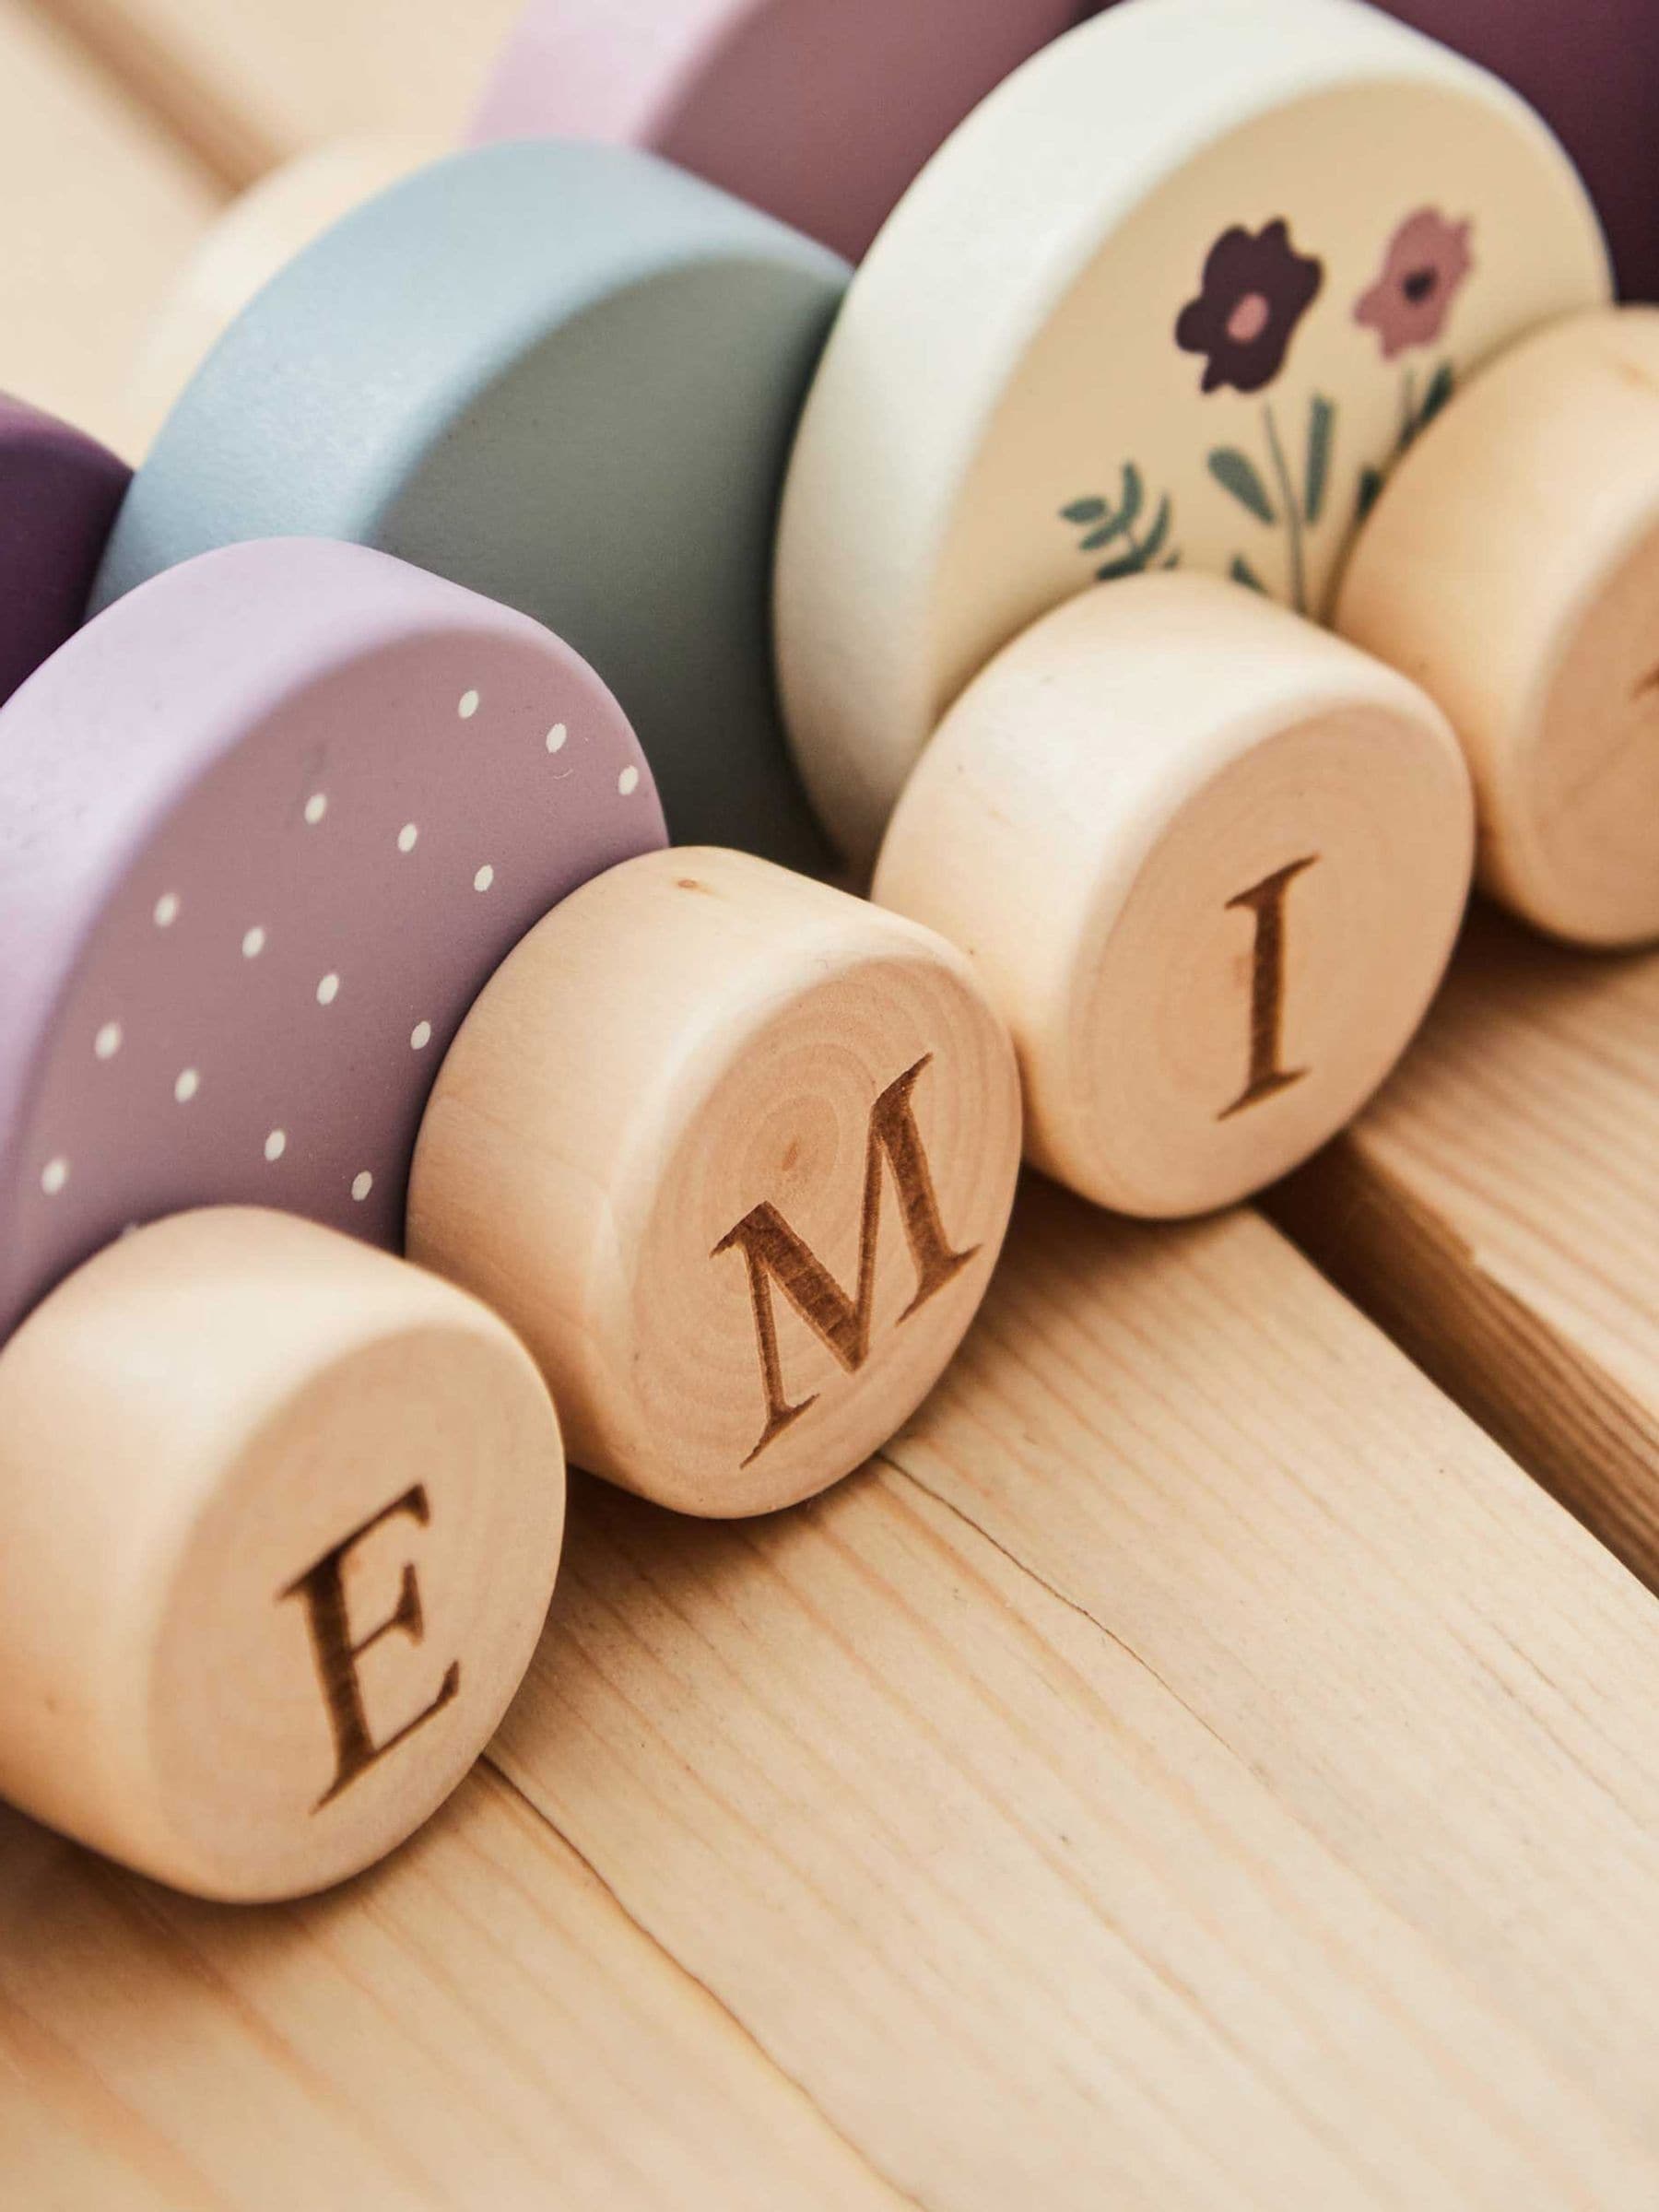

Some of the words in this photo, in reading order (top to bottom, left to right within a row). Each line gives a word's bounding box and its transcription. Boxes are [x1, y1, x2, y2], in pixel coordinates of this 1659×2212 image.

[1216, 853, 1321, 1122] I
[710, 1052, 982, 1469] M
[276, 1482, 460, 1816] E
